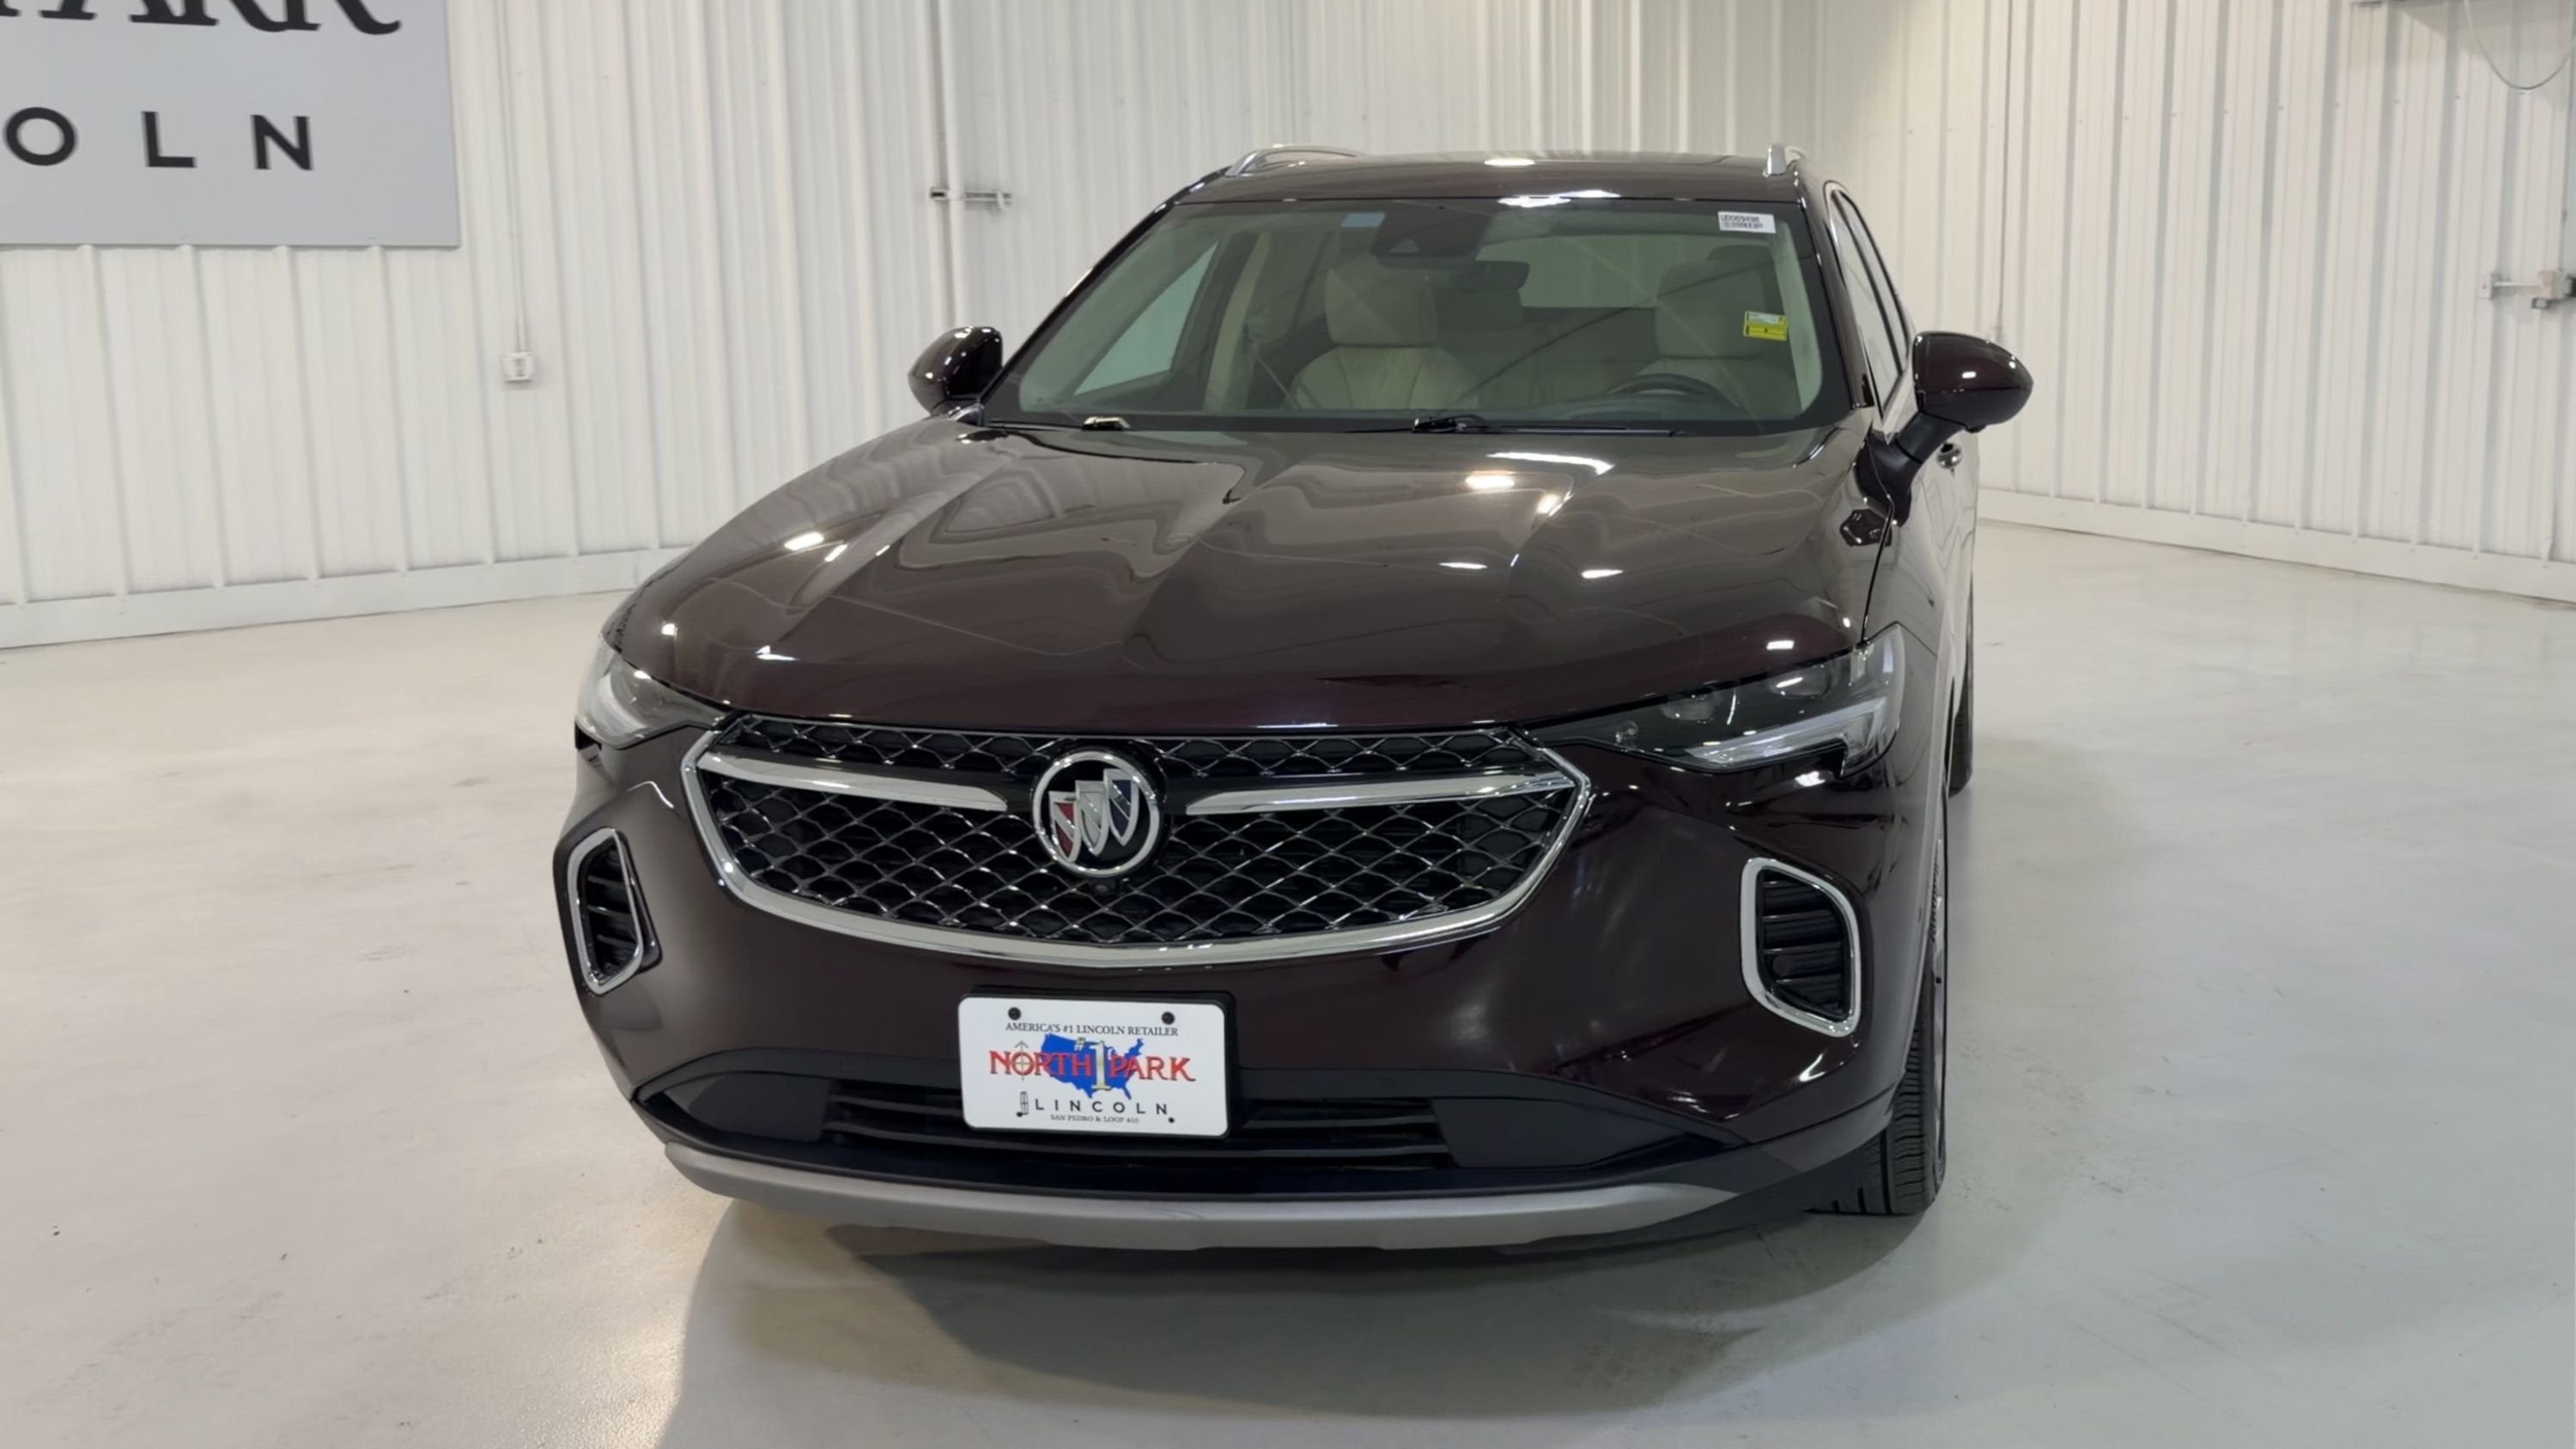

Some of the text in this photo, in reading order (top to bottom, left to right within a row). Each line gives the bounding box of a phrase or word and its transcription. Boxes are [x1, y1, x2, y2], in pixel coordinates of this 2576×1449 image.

[1005, 1022, 1178, 1037] AMERICA'S #1 LINCOLN RETAILER
[989, 1050, 1196, 1082] NORTH PARK
[1036, 1098, 1168, 1114] LINCOLN
